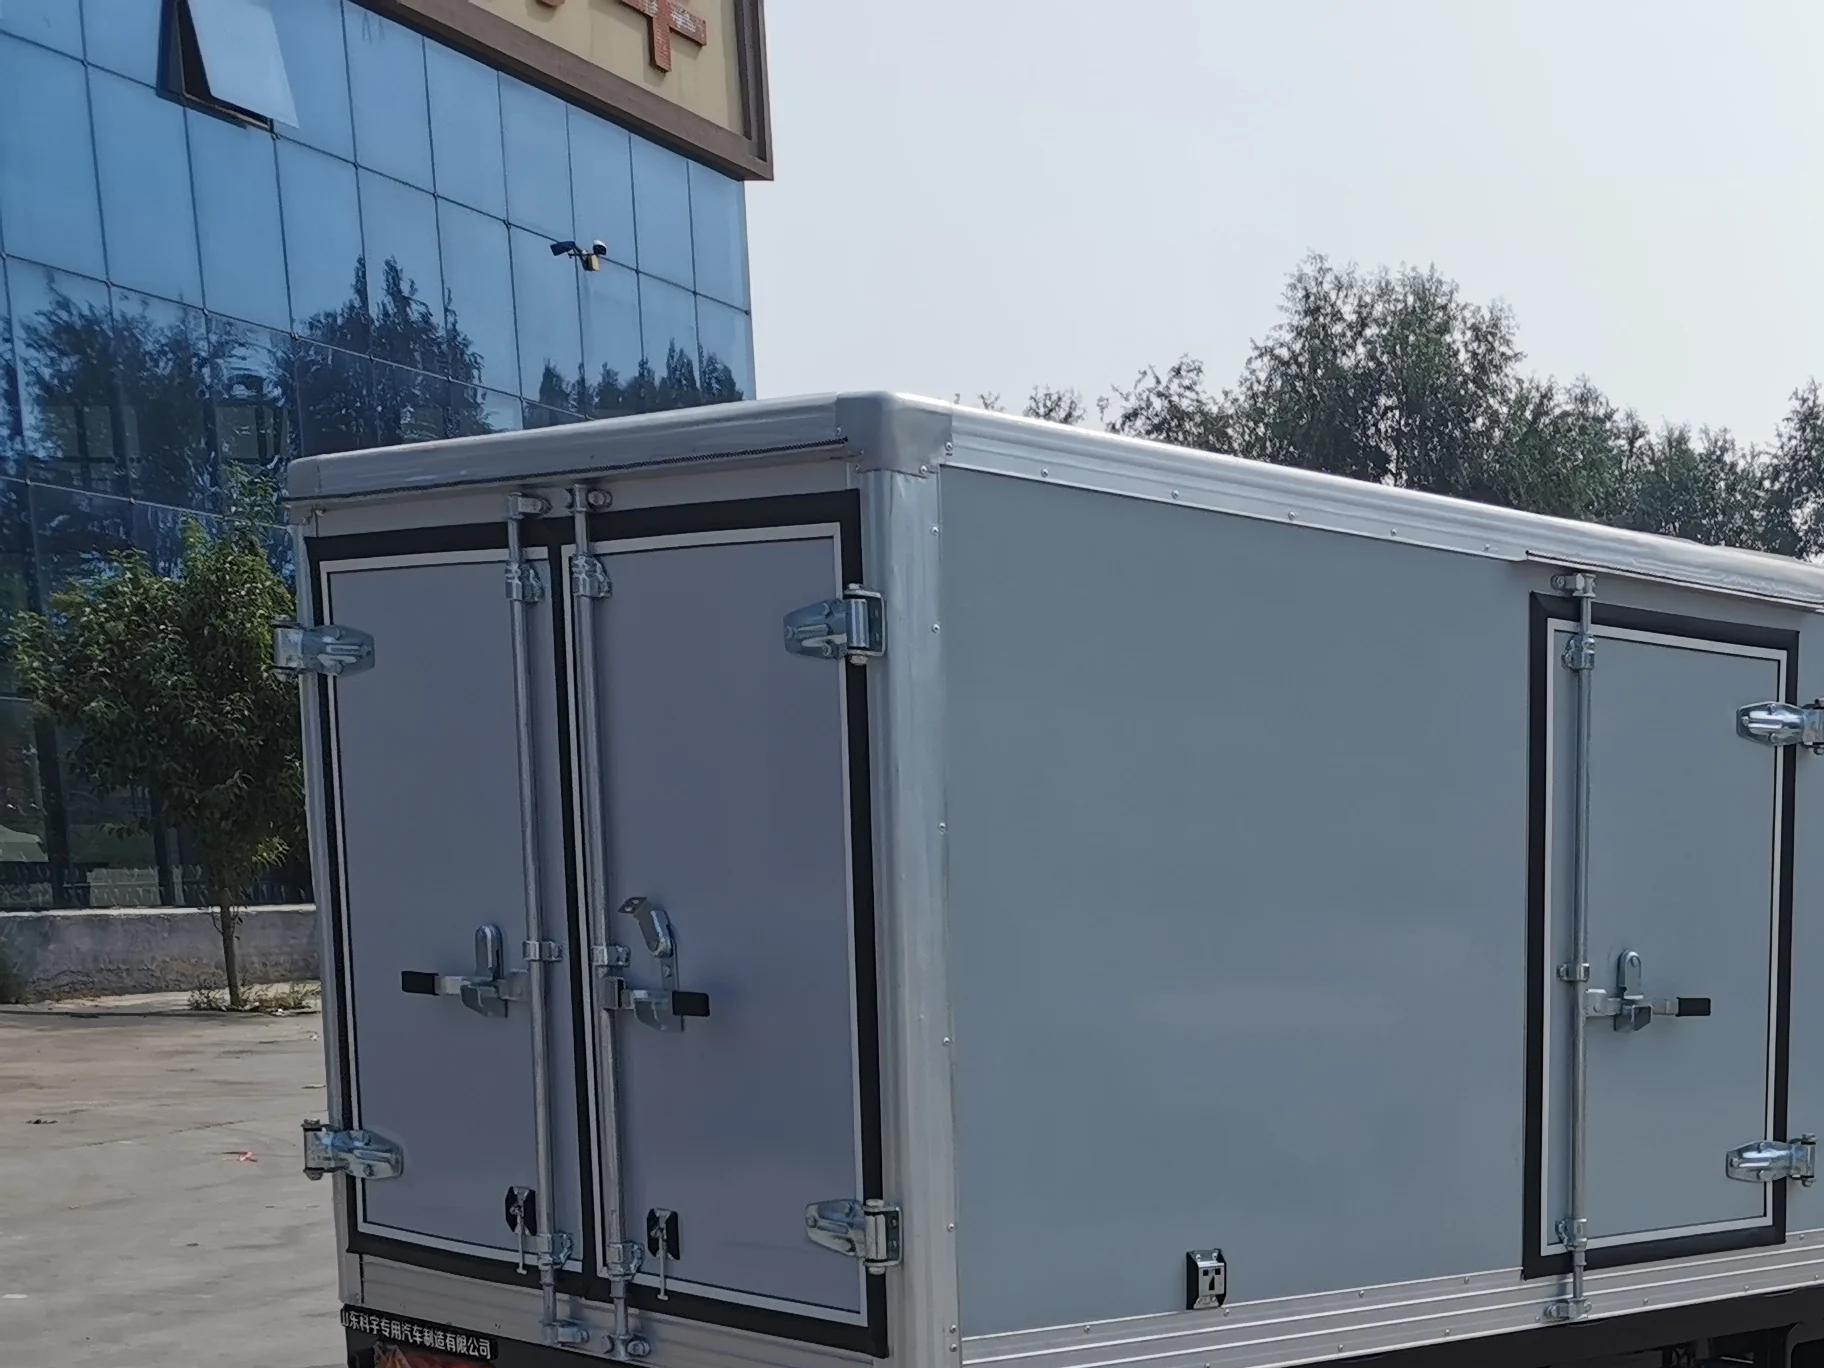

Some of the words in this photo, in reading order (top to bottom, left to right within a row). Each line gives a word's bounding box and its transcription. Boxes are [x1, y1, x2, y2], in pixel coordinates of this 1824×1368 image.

[341, 1310, 491, 1359] 山东科宇专用汽车制造有限公司
